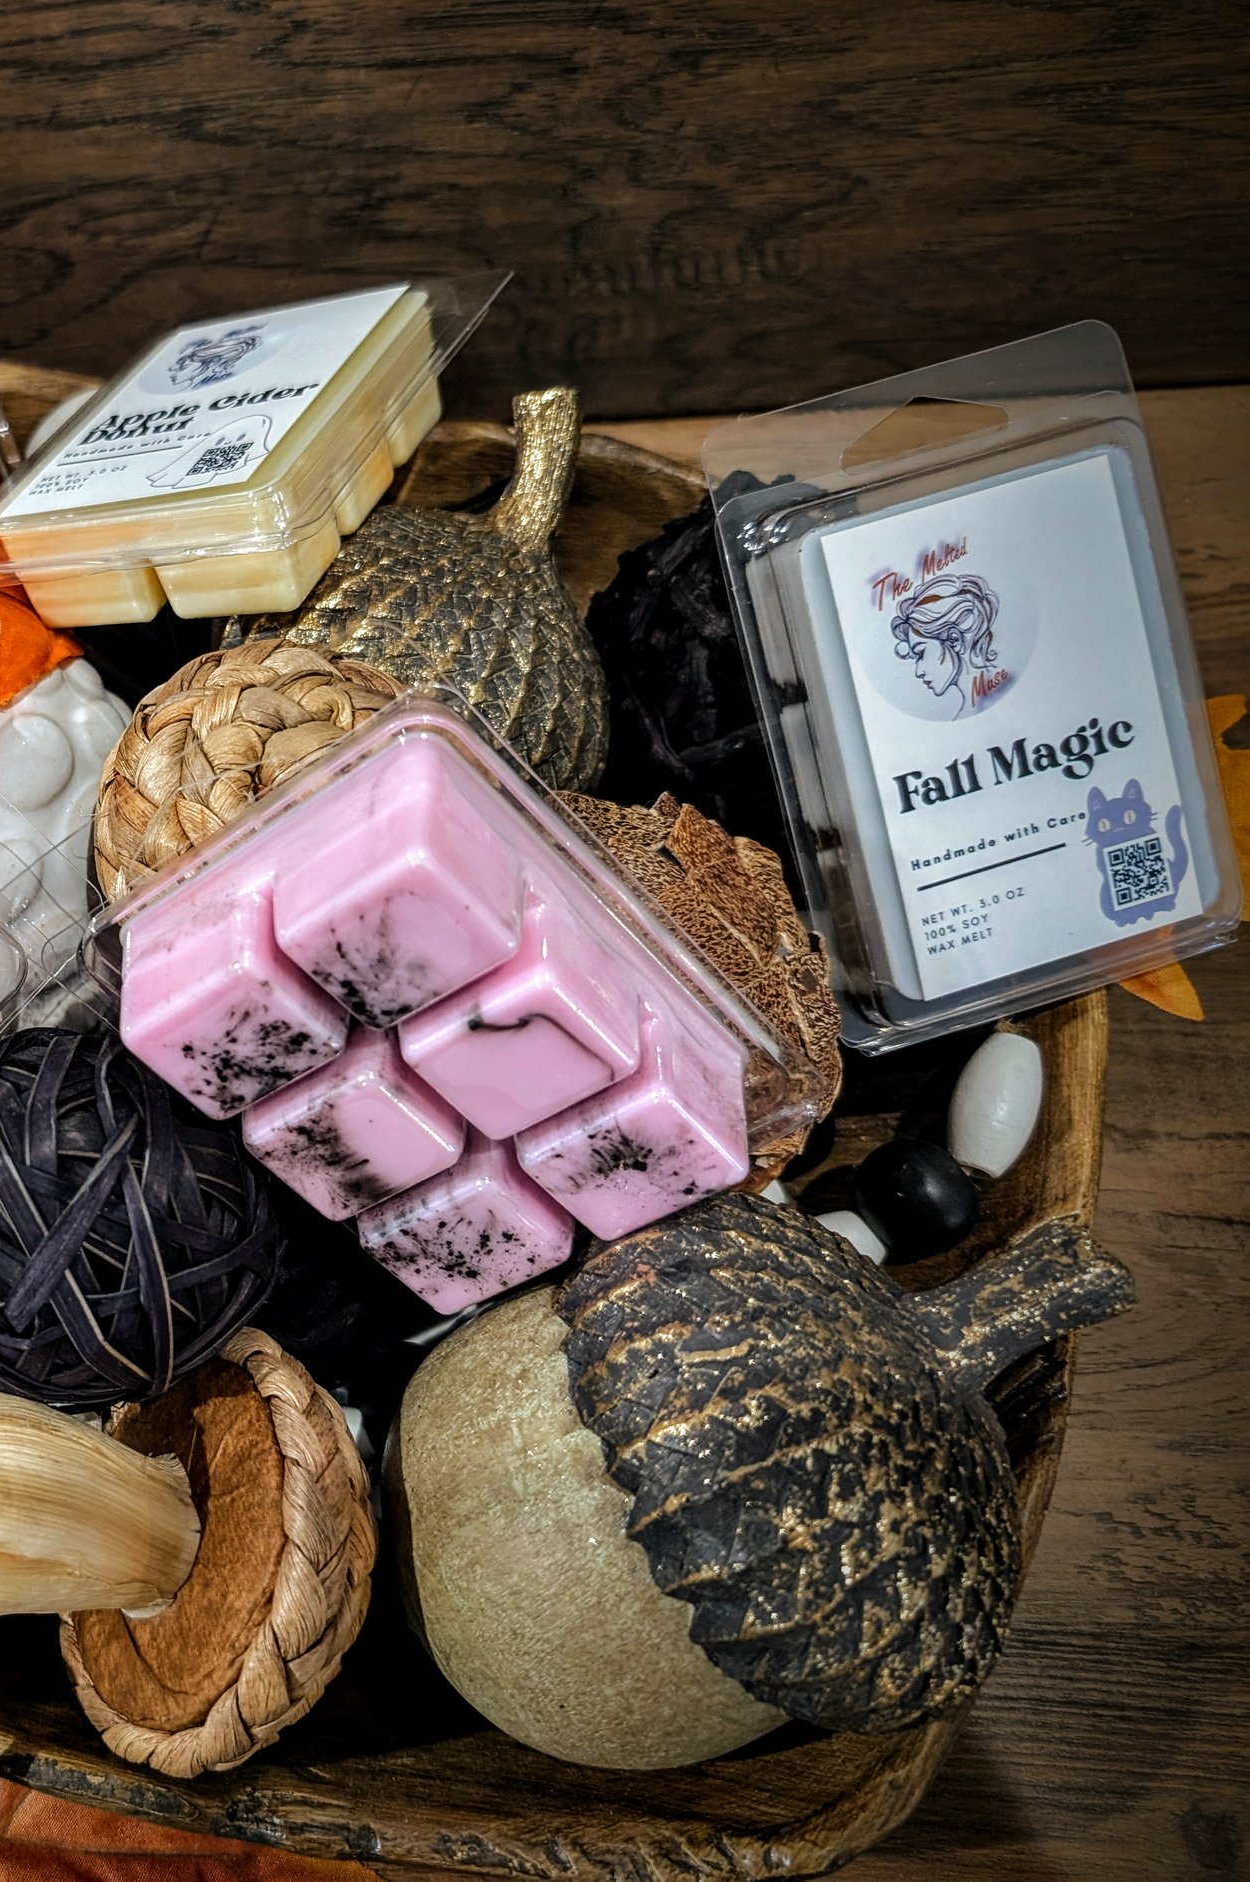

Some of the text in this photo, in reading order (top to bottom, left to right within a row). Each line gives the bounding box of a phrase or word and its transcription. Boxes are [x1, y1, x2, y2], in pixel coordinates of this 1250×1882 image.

[89, 383, 320, 434] Apple Cider
[63, 444, 134, 459] Handmade
[140, 438, 170, 448] with
[78, 416, 196, 446] Donut
[872, 536, 968, 611] The Melted
[971, 669, 1008, 708] Muse
[892, 717, 1135, 815] Fall Magic
[911, 811, 1086, 871] Handmade with Care
[922, 911, 944, 927] NET
[950, 904, 973, 917] WT.
[1005, 887, 1025, 900] OZ
[924, 913, 989, 941] 100% SOY
[927, 927, 993, 956] WAX MELT
